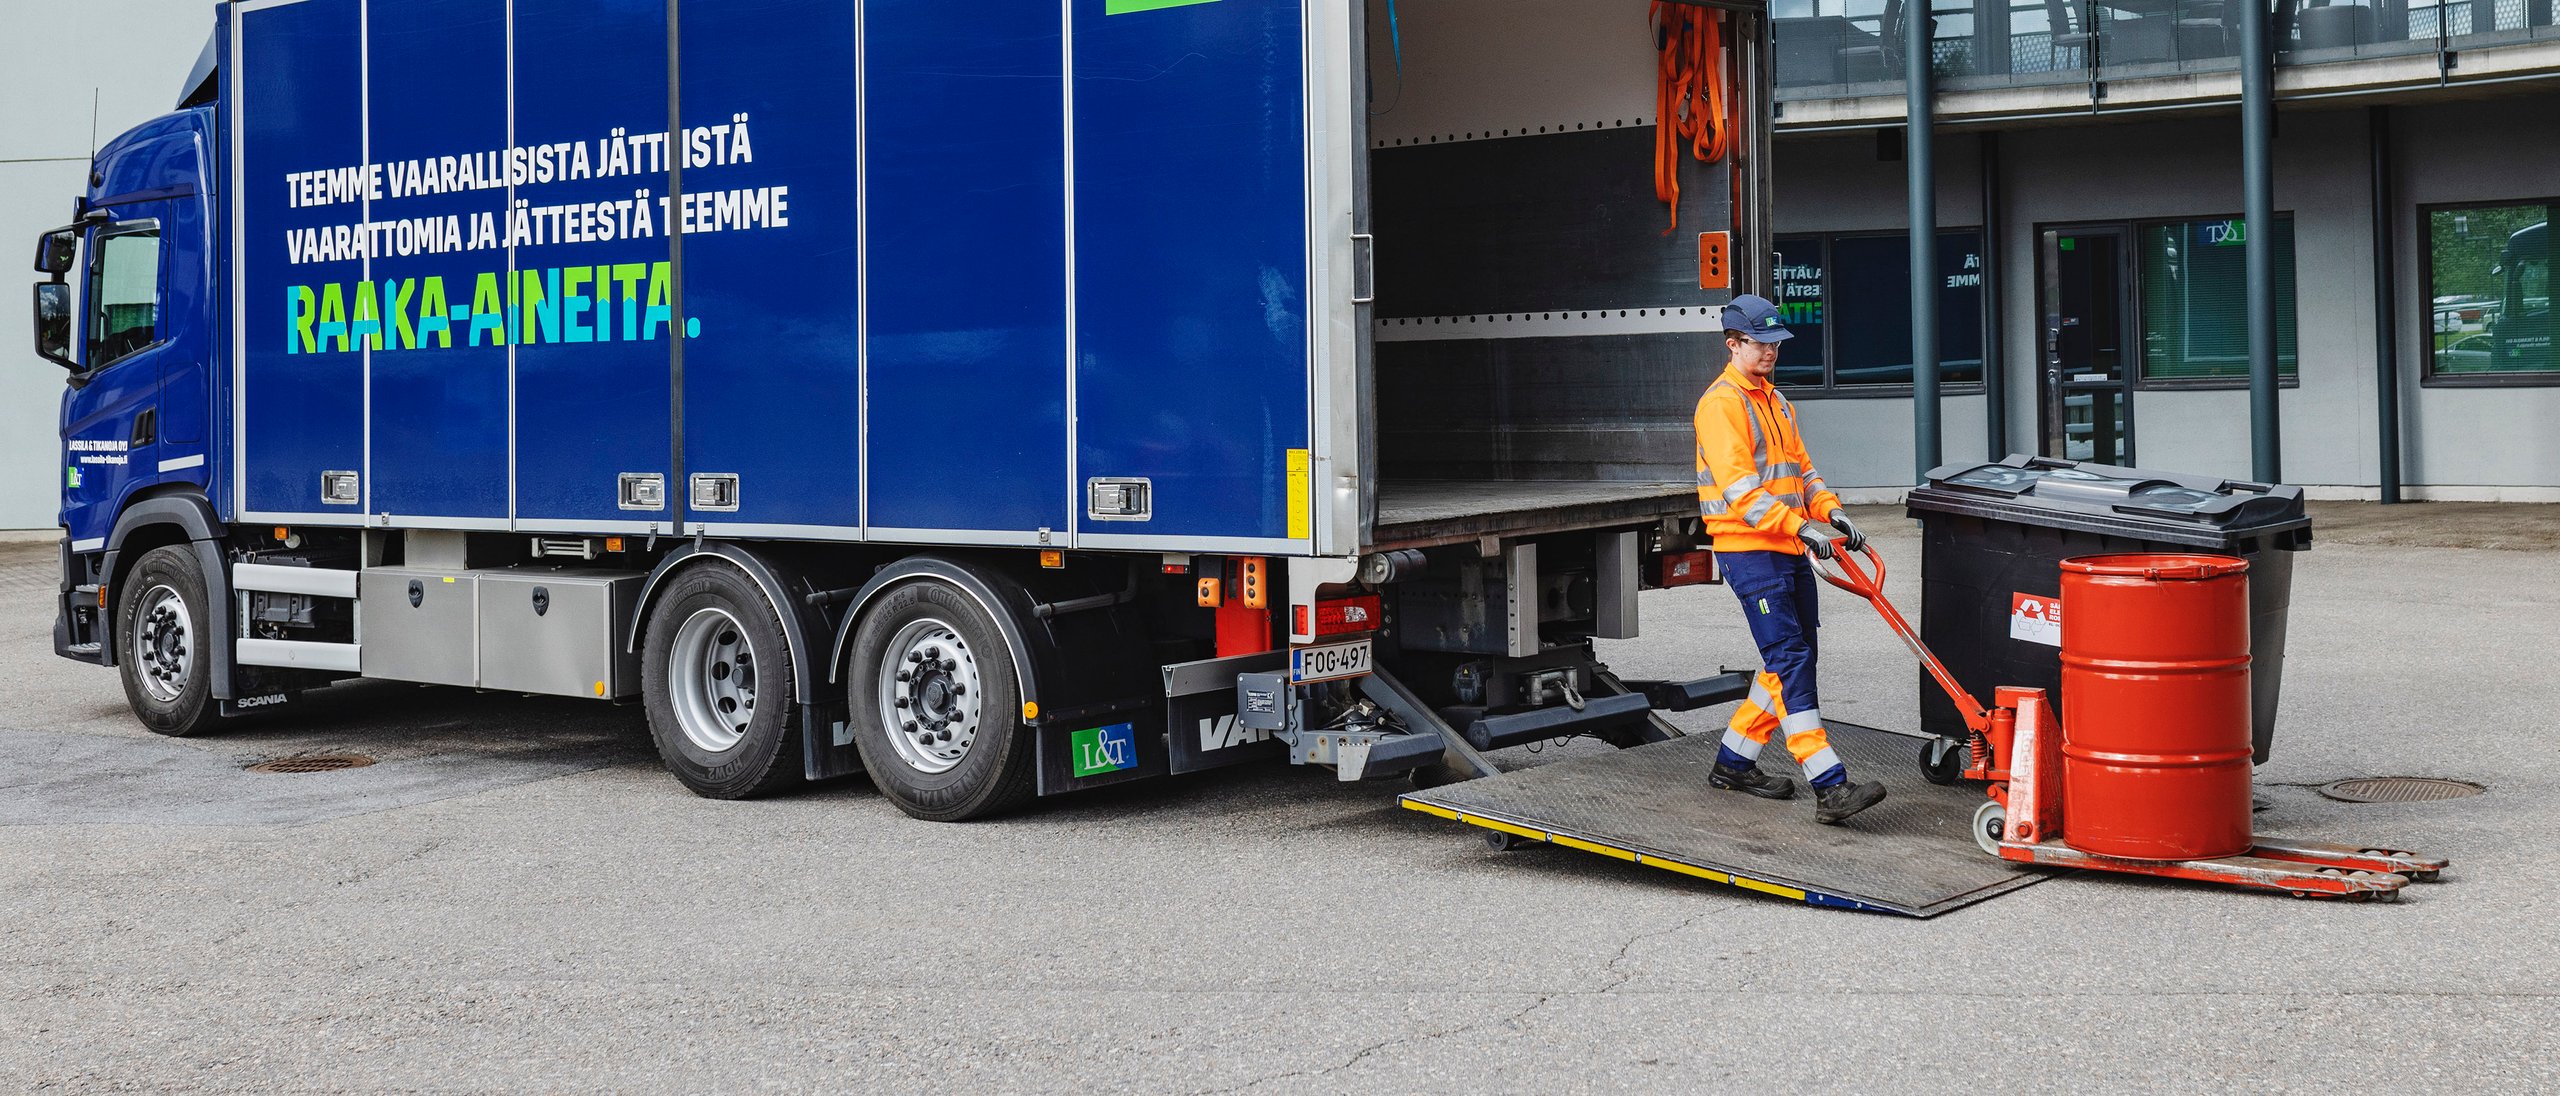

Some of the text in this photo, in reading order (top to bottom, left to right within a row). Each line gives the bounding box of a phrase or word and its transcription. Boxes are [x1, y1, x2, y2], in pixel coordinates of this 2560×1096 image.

[286, 164, 383, 209] TEEMME
[387, 141, 591, 199] VAARALLISISTA
[286, 214, 463, 265] VAARATTOMIA
[467, 211, 497, 251] JA
[502, 188, 654, 249] JÄTTEESTÄ
[287, 261, 701, 355] RAAKA-AINEITA.
[89, 440, 93, 451] &
[237, 693, 288, 708] SCANIA
[1082, 729, 1127, 770] L&T
